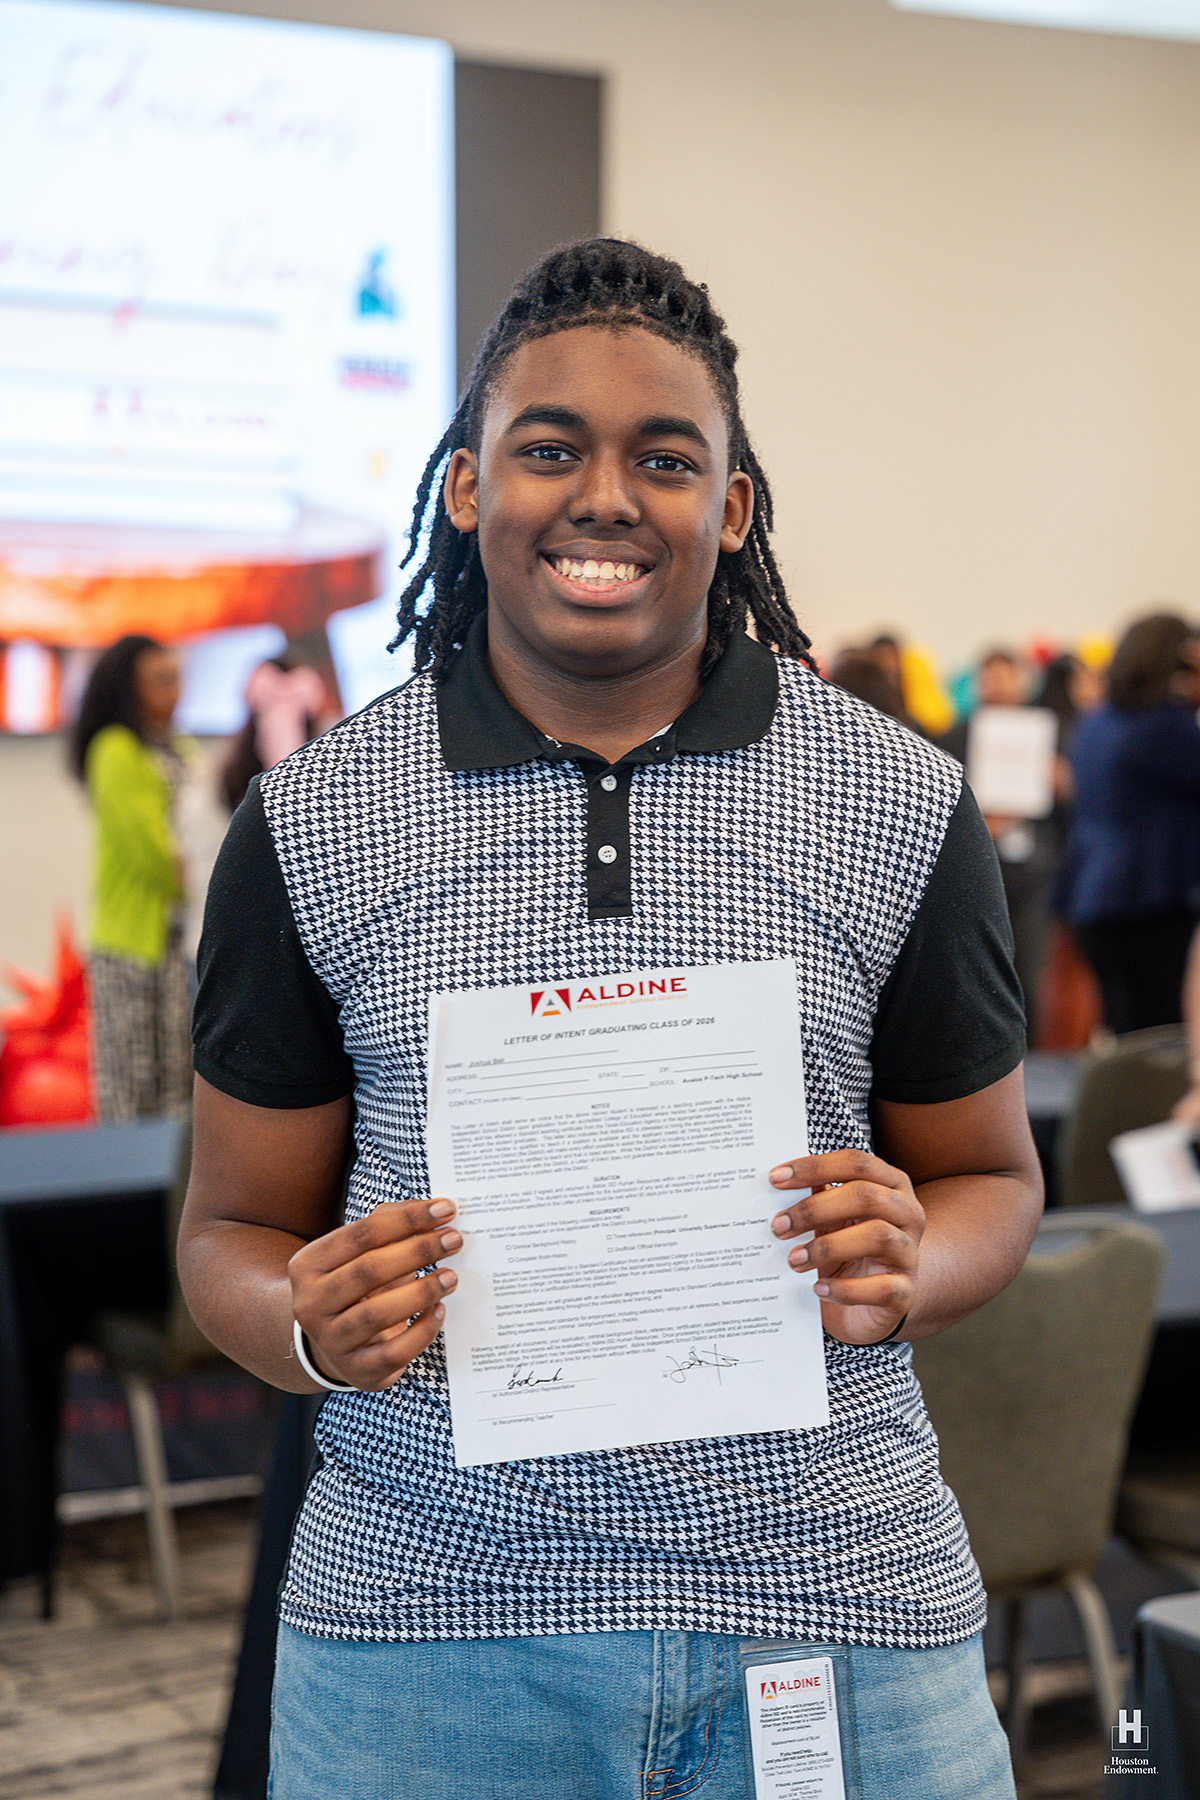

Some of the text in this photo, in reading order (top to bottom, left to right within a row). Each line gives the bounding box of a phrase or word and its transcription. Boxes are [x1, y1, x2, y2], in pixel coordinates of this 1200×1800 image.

[576, 977, 687, 1002] ALDINE
[504, 1016, 716, 1045] LETTER OF INTENT GRADUATING CLASS OF 2026
[448, 1098, 482, 1107] CONTACT
[726, 1072, 740, 1080] High
[742, 1070, 763, 1078] School
[589, 1206, 630, 1215] REQUIREMENTS
[778, 1676, 820, 1691] ALDINE
